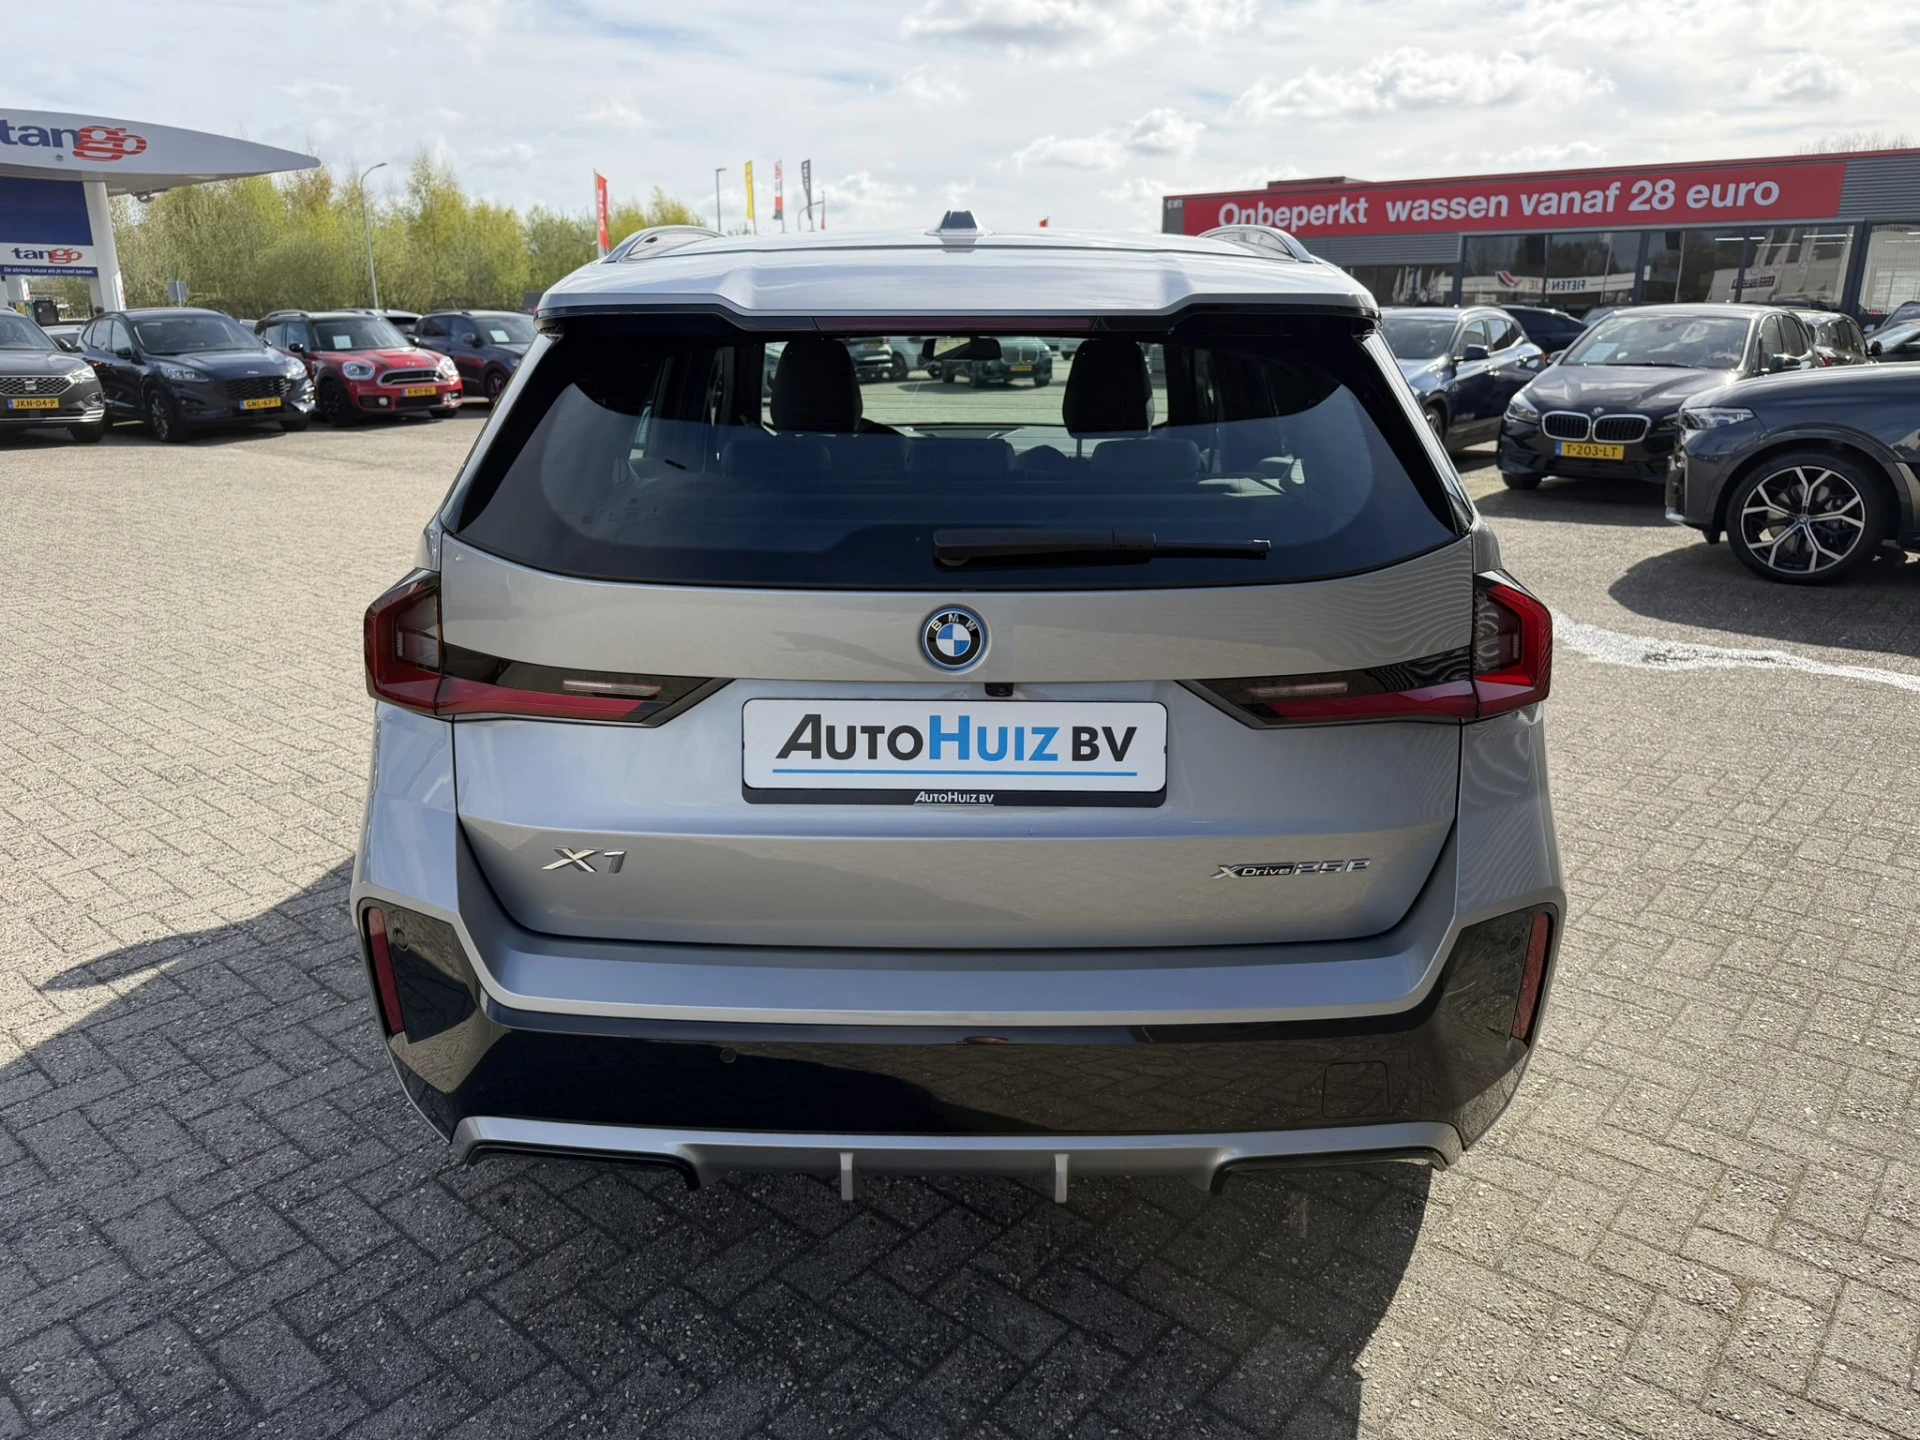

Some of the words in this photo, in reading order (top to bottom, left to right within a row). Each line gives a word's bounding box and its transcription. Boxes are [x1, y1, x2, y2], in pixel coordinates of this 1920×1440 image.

[0, 119, 147, 162] tango
[1218, 197, 1368, 232] Onbeperkt
[1386, 194, 1509, 222] wassen
[1520, 181, 1622, 216] vanaf
[1628, 178, 1676, 212] 28
[1686, 180, 1780, 210] euro
[11, 247, 83, 265] tango
[1565, 444, 1619, 457] T-203-LT
[931, 613, 977, 632] BMW
[1071, 726, 1138, 762] BV
[979, 794, 995, 803] BV
[541, 847, 627, 874] X1
